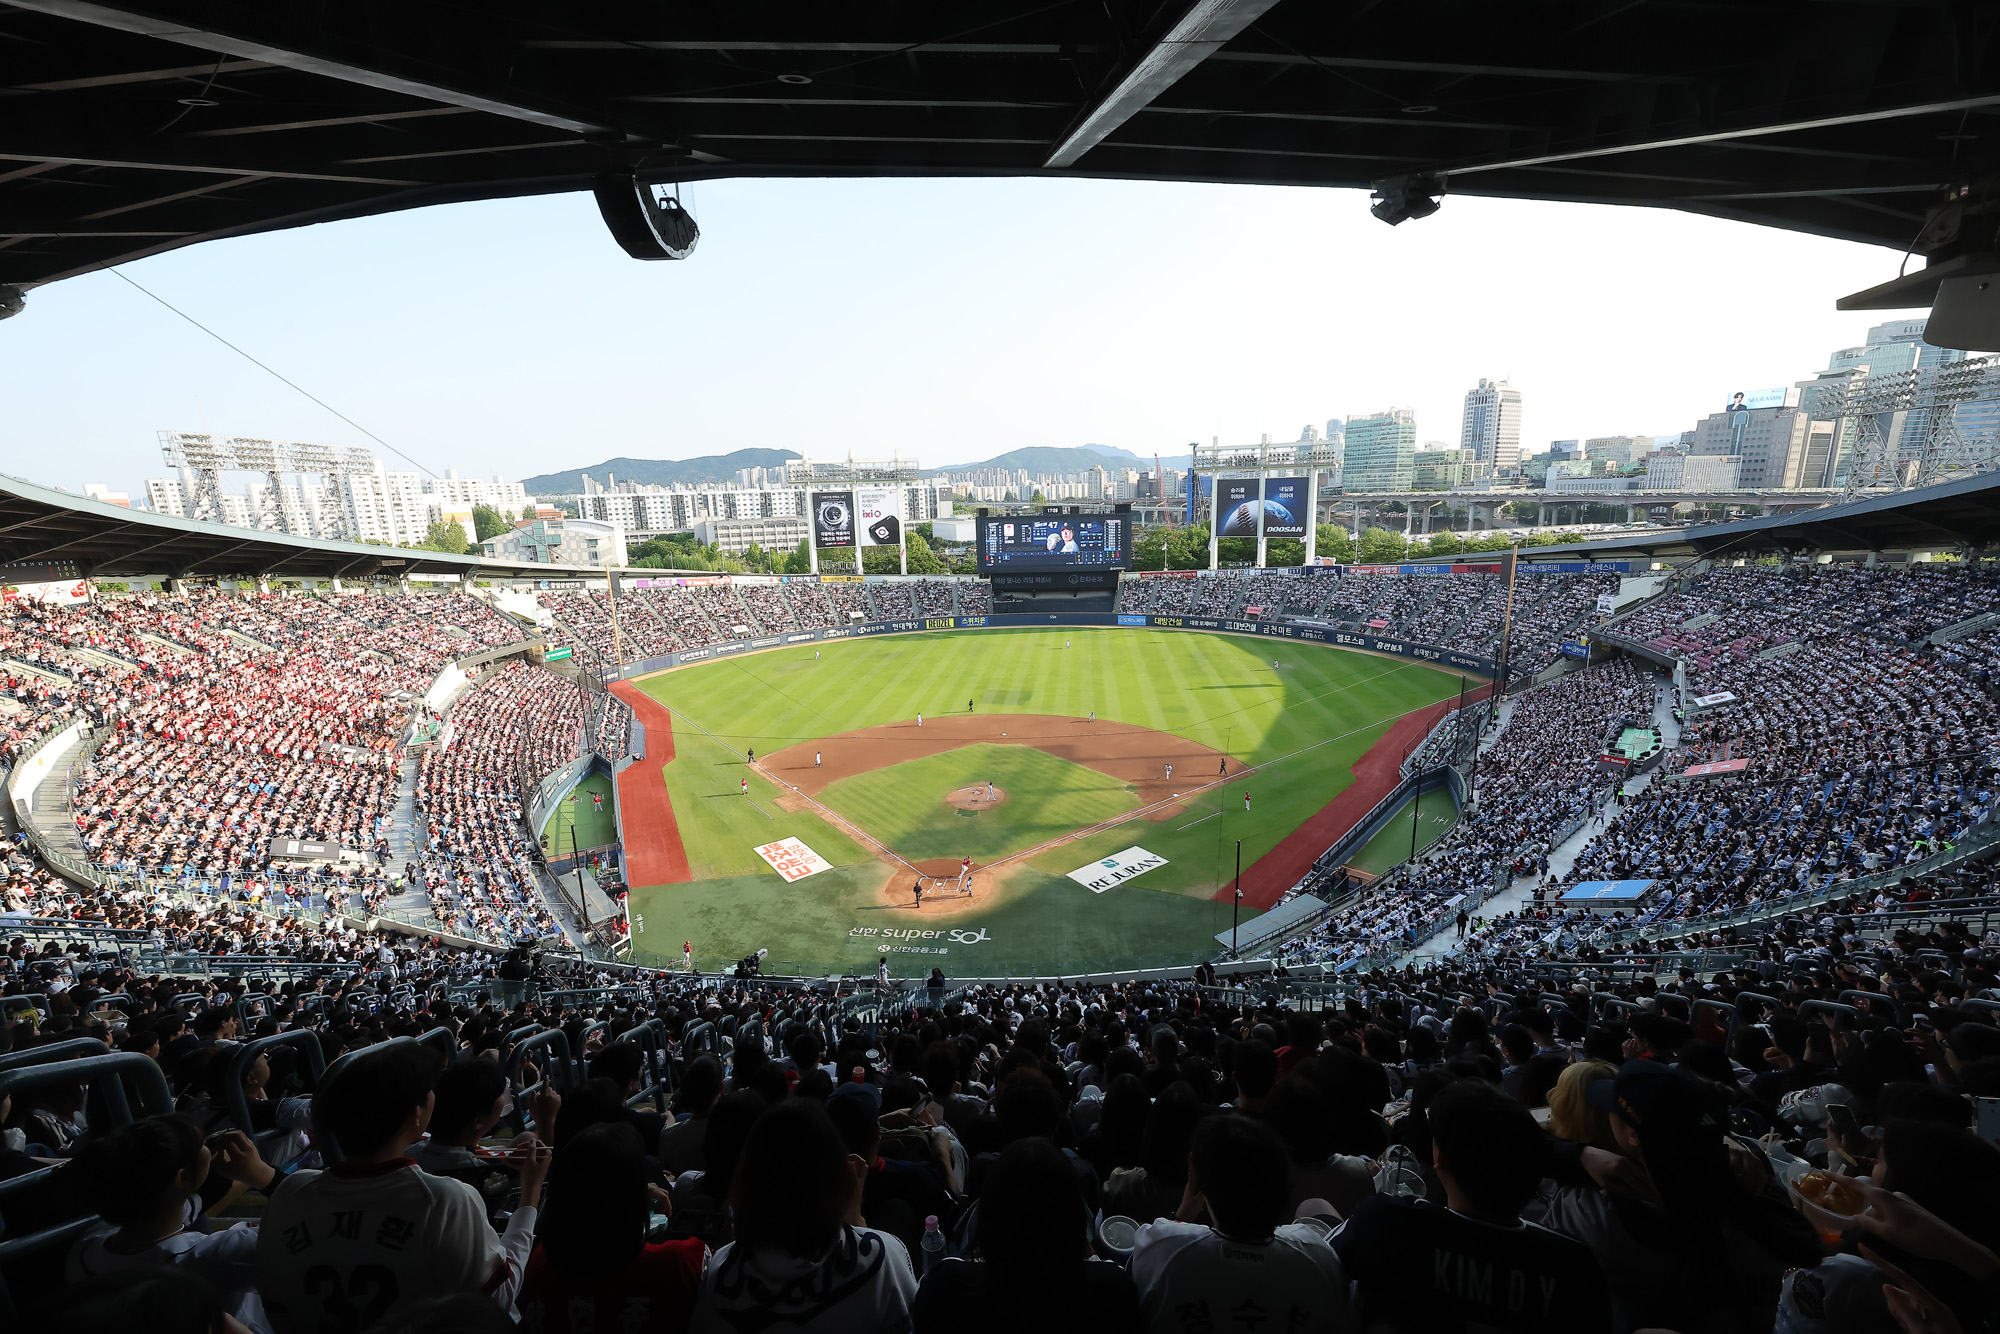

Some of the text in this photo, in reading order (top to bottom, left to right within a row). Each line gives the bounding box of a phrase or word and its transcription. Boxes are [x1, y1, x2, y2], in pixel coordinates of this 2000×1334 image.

[892, 622, 918, 630] 현대해상
[929, 619, 951, 628] REUZEL
[1155, 618, 1183, 626] 대방건설
[1234, 622, 1256, 632] 대보건설
[1263, 625, 1292, 635] 금천미트
[1089, 858, 1162, 890] REJURAN
[848, 927, 992, 944] 신한 super SOL
[892, 946, 948, 955] 신한금융그룹
[282, 1211, 415, 1255] 김재환
[1434, 1247, 1493, 1305] KIM
